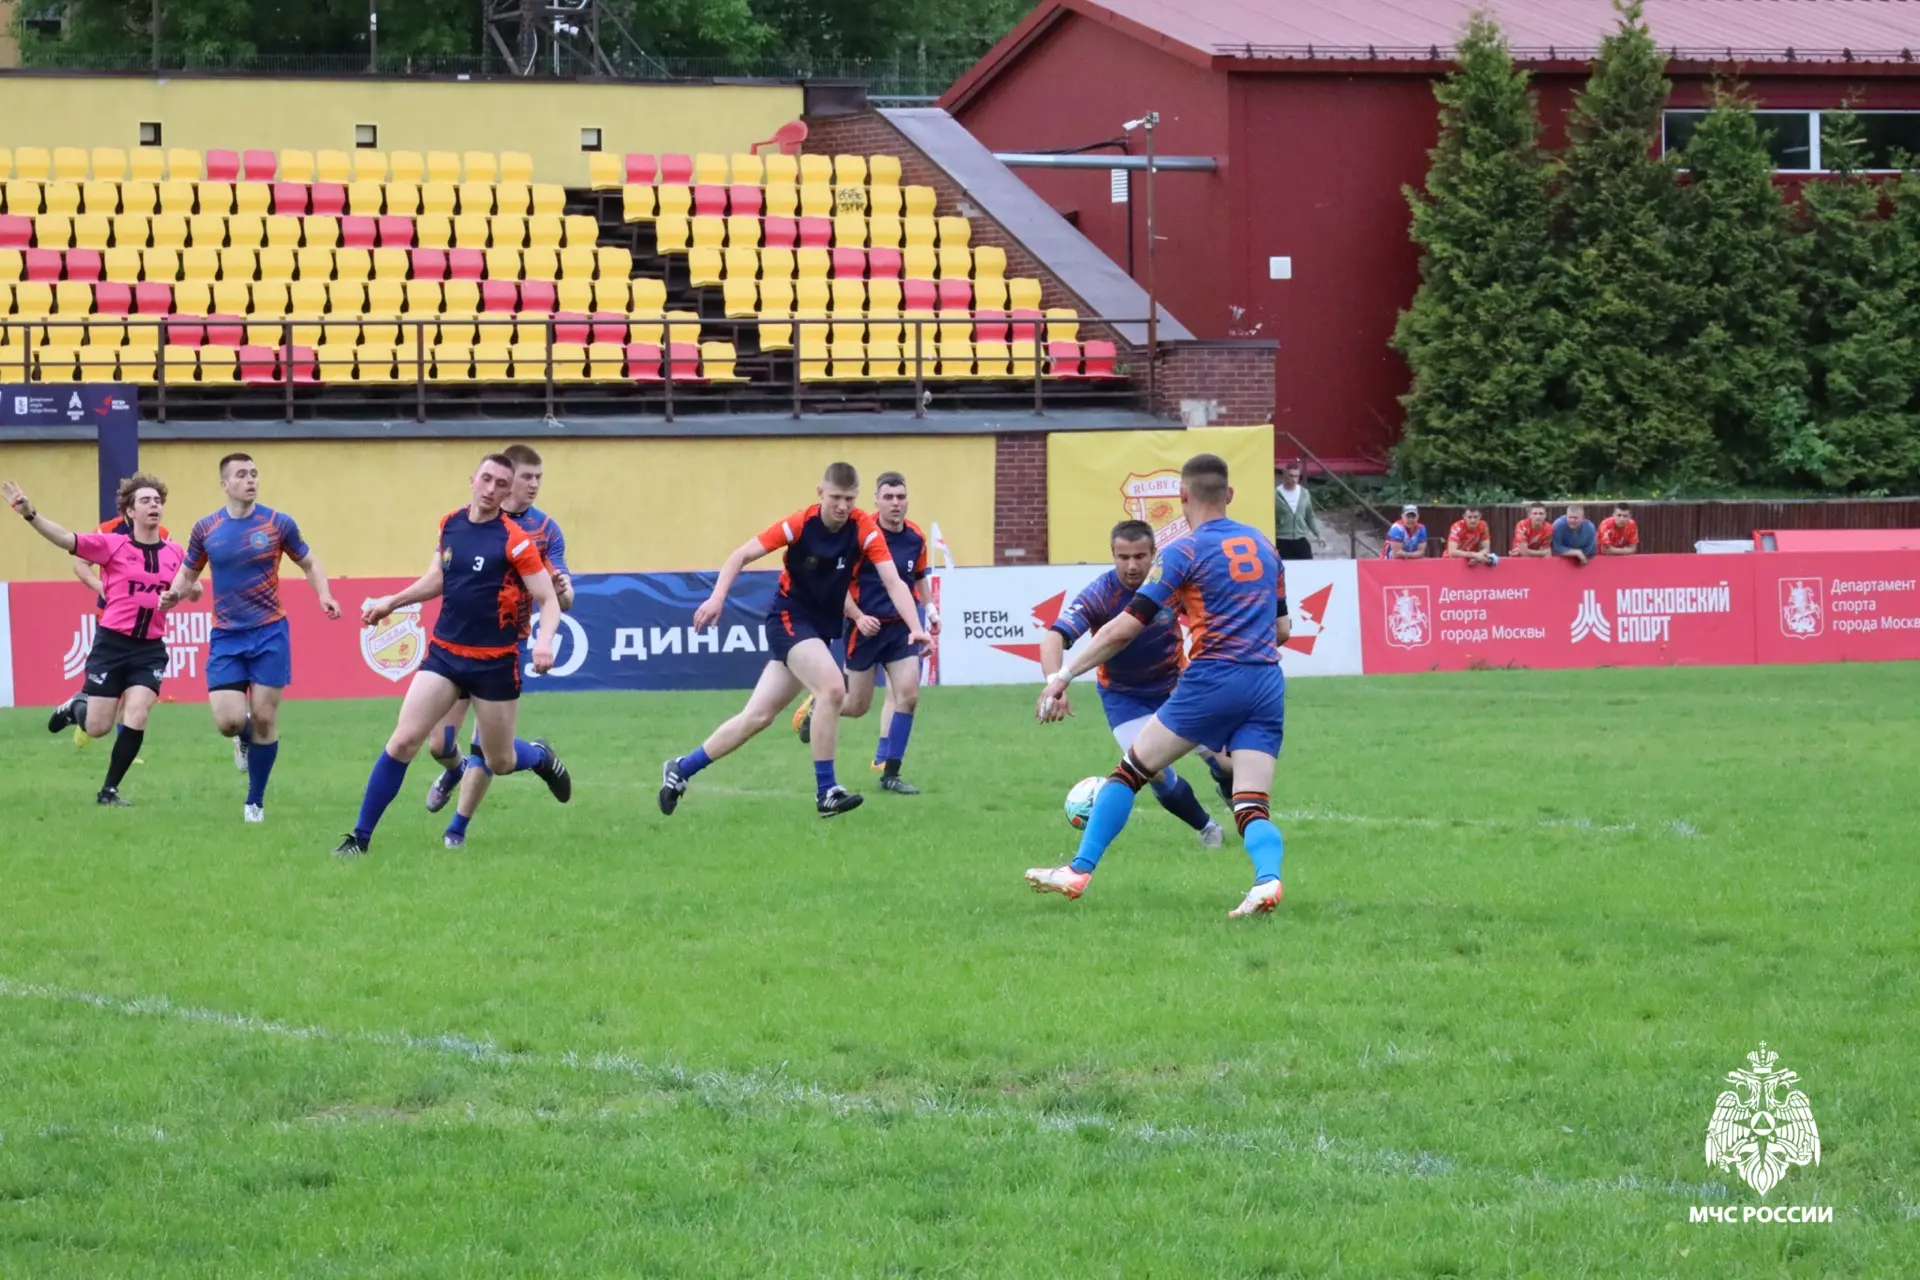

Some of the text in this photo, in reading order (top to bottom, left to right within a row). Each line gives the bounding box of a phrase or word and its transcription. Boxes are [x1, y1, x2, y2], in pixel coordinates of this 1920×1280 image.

[472, 556, 485, 571] 3
[907, 560, 914, 572] 9
[1221, 536, 1264, 583] 8
[1439, 587, 1530, 604] Департамент
[1831, 579, 1917, 596] Департамент
[1616, 580, 1731, 615] МОСКОВСКИЙ
[1832, 600, 1877, 614] спорта
[963, 611, 1009, 624] РЕГБИ
[1440, 608, 1487, 624] спорта
[964, 625, 1025, 639] РОССИИ
[1441, 625, 1545, 644] города Москвы
[1617, 615, 1672, 643] СПОРТ
[1832, 619, 1878, 634] города
[611, 624, 769, 661] ДИНА
